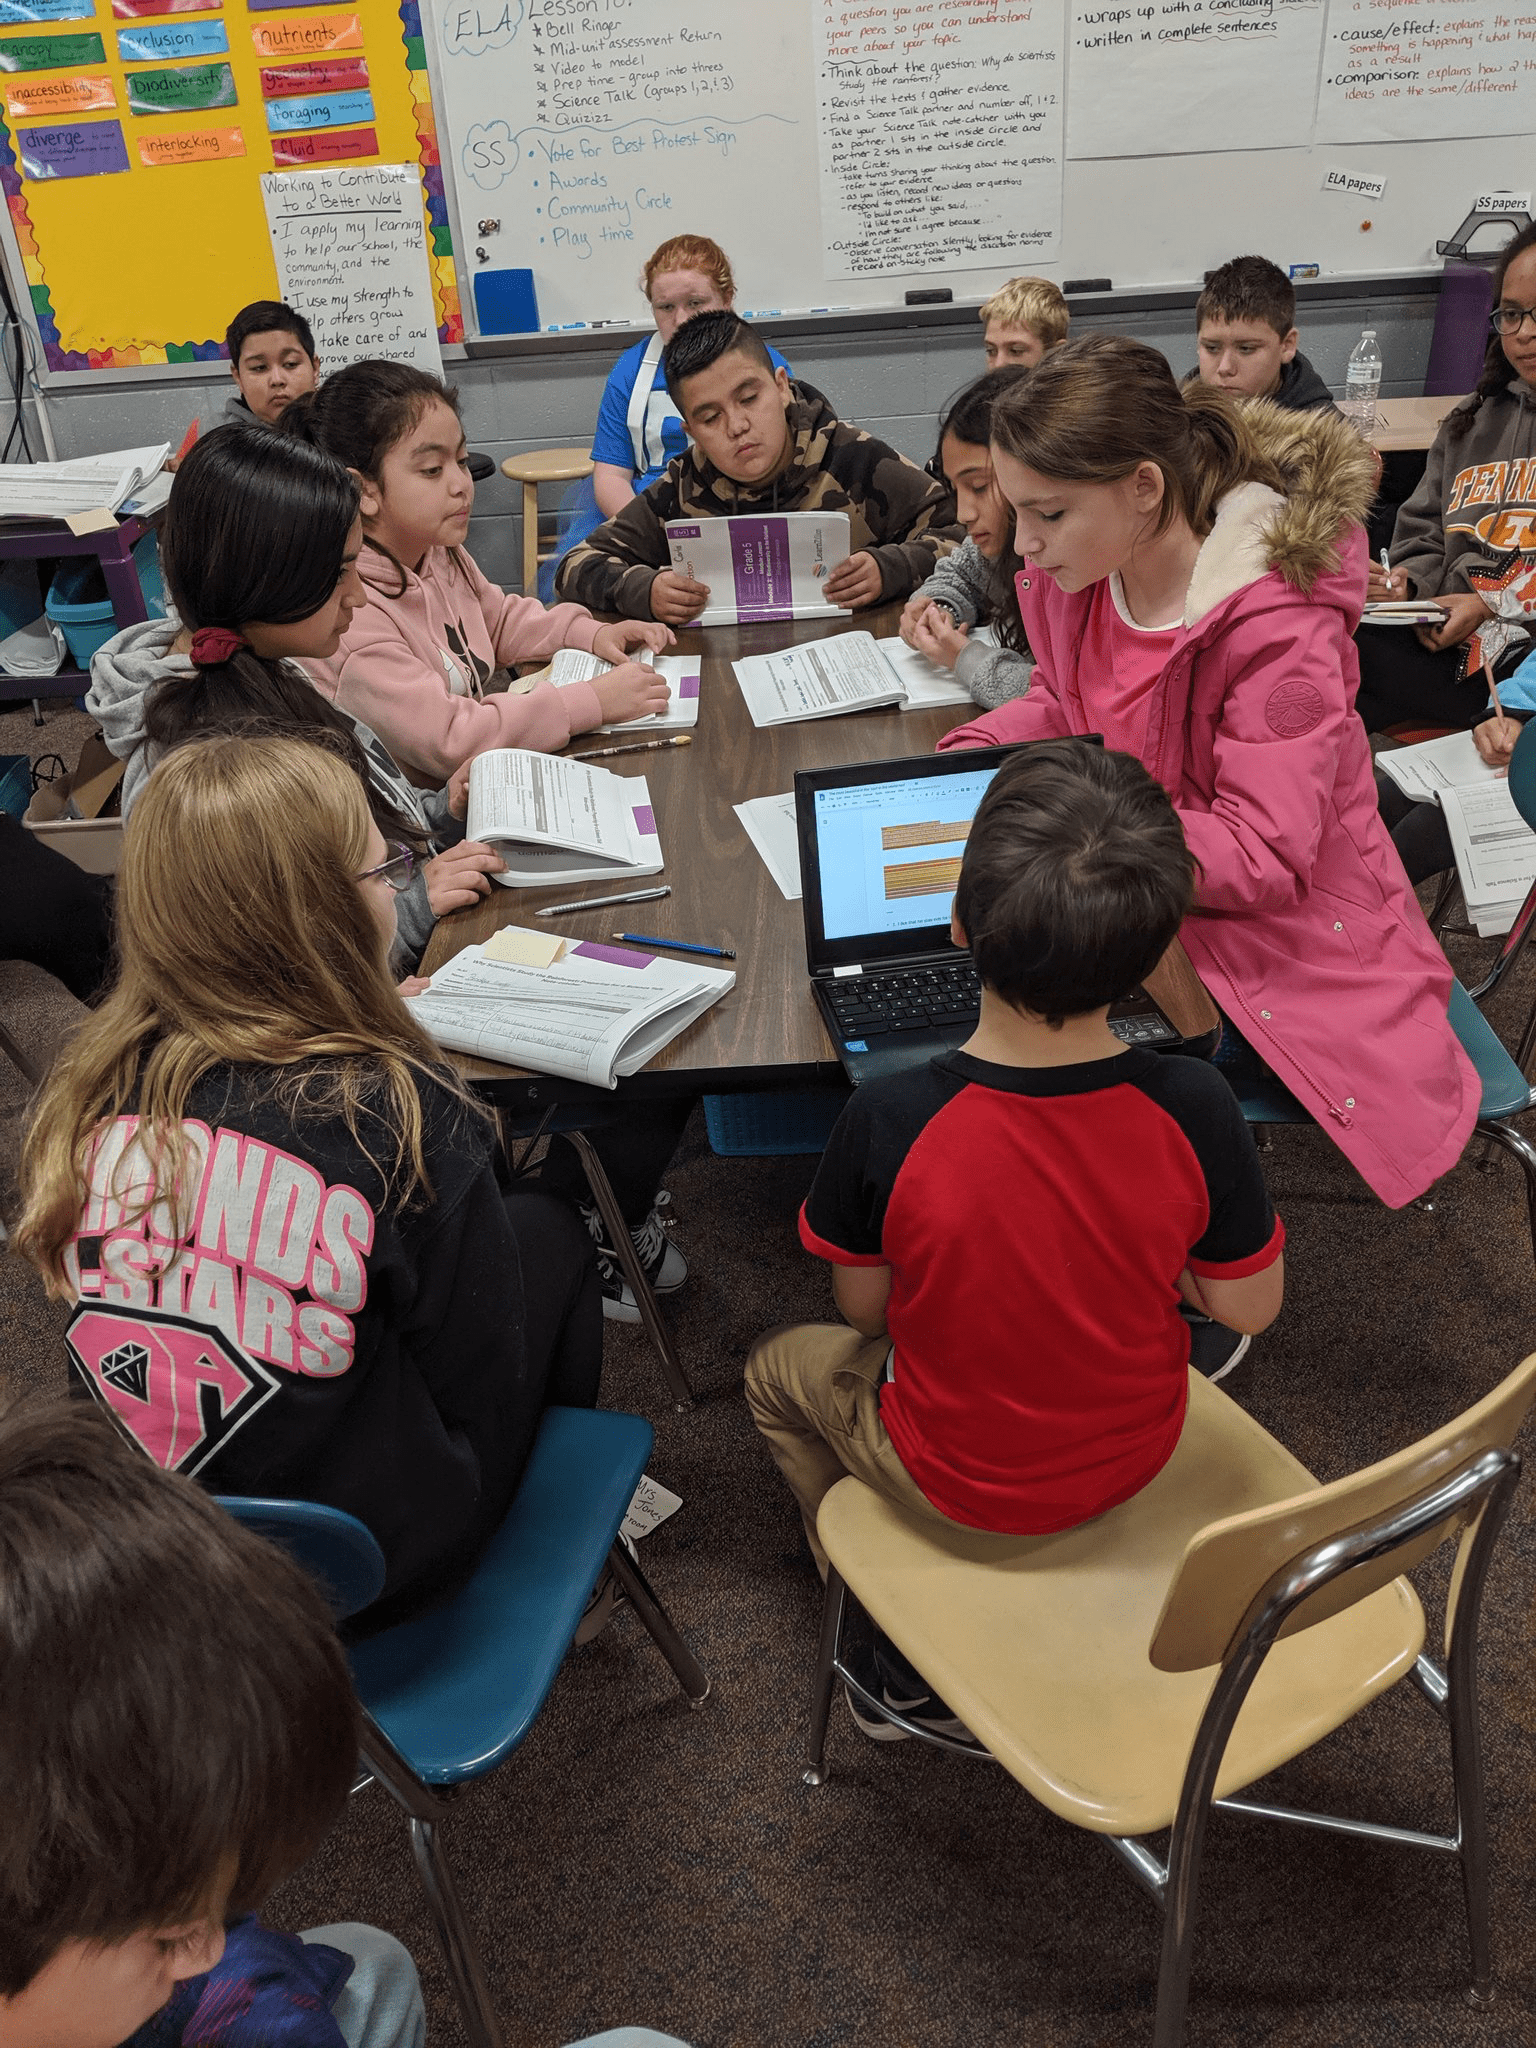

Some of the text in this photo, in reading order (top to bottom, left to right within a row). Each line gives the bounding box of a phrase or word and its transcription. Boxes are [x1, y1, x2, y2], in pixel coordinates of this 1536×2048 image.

[529, 0, 598, 20] Lesson
[825, 15, 834, 24] a
[840, 6, 887, 26] question
[893, 7, 911, 21] you
[915, 3, 934, 12] are
[1084, 9, 1132, 24] wraps
[1137, 6, 1155, 20] up
[1162, 1, 1190, 14] with
[1194, 2, 1202, 12] a
[1353, 2, 1360, 11] a
[455, 4, 511, 42] ELA
[547, 18, 622, 40] Bell Ringer
[827, 7, 1032, 46] your peers so you can understand
[1084, 19, 1278, 48] written in complete sentences
[1340, 19, 1440, 41] cause/effect:
[1494, 15, 1510, 28] the
[261, 23, 337, 46] nutrients
[551, 28, 722, 56] Mid-unit assessment Return
[1349, 41, 1400, 56] something
[1408, 38, 1417, 49] is
[1422, 36, 1473, 50] happening
[1485, 32, 1511, 43] what
[828, 45, 859, 57] more
[864, 40, 895, 52] about
[902, 40, 926, 56] your
[551, 54, 644, 75] Video to model
[827, 65, 863, 79] Think
[866, 62, 899, 76] about
[904, 61, 926, 73] the
[1003, 52, 1015, 63] do
[1347, 53, 1422, 68] as a result
[554, 79, 582, 91] Prep
[587, 76, 615, 86] time
[665, 66, 687, 76] into
[691, 61, 724, 72] threes
[872, 77, 887, 86] the
[1427, 64, 1472, 81] explains
[553, 93, 601, 109] Science
[604, 90, 637, 104] Talk
[1345, 87, 1375, 100] ideas
[1382, 88, 1401, 97] are
[1406, 85, 1424, 96] the
[274, 103, 331, 123] foraging
[26, 129, 85, 153] diverge
[146, 135, 220, 152] interlocking
[280, 139, 315, 156] fluid
[537, 126, 737, 164] Vote for Best Protest Sign
[472, 141, 506, 168] SS
[263, 169, 406, 202] Working to Contribute
[550, 171, 607, 191] Awards
[1327, 172, 1382, 193] ELA papers
[282, 192, 402, 212] to a Better World
[548, 187, 673, 227] Community Circle
[1477, 196, 1527, 211] SS papers
[280, 217, 422, 245] I apply my learning
[284, 245, 297, 258] to
[305, 244, 331, 256] help
[337, 243, 357, 252] our
[403, 238, 423, 249] the
[553, 226, 634, 260] Play time
[341, 257, 362, 268] and
[371, 257, 391, 267] the
[292, 286, 414, 313] I use my strength to
[307, 310, 403, 330] elp others grow
[320, 326, 427, 348] take care of and
[379, 347, 416, 359] shared
[743, 549, 754, 575] Grade
[634, 1499, 664, 1522] Jones
